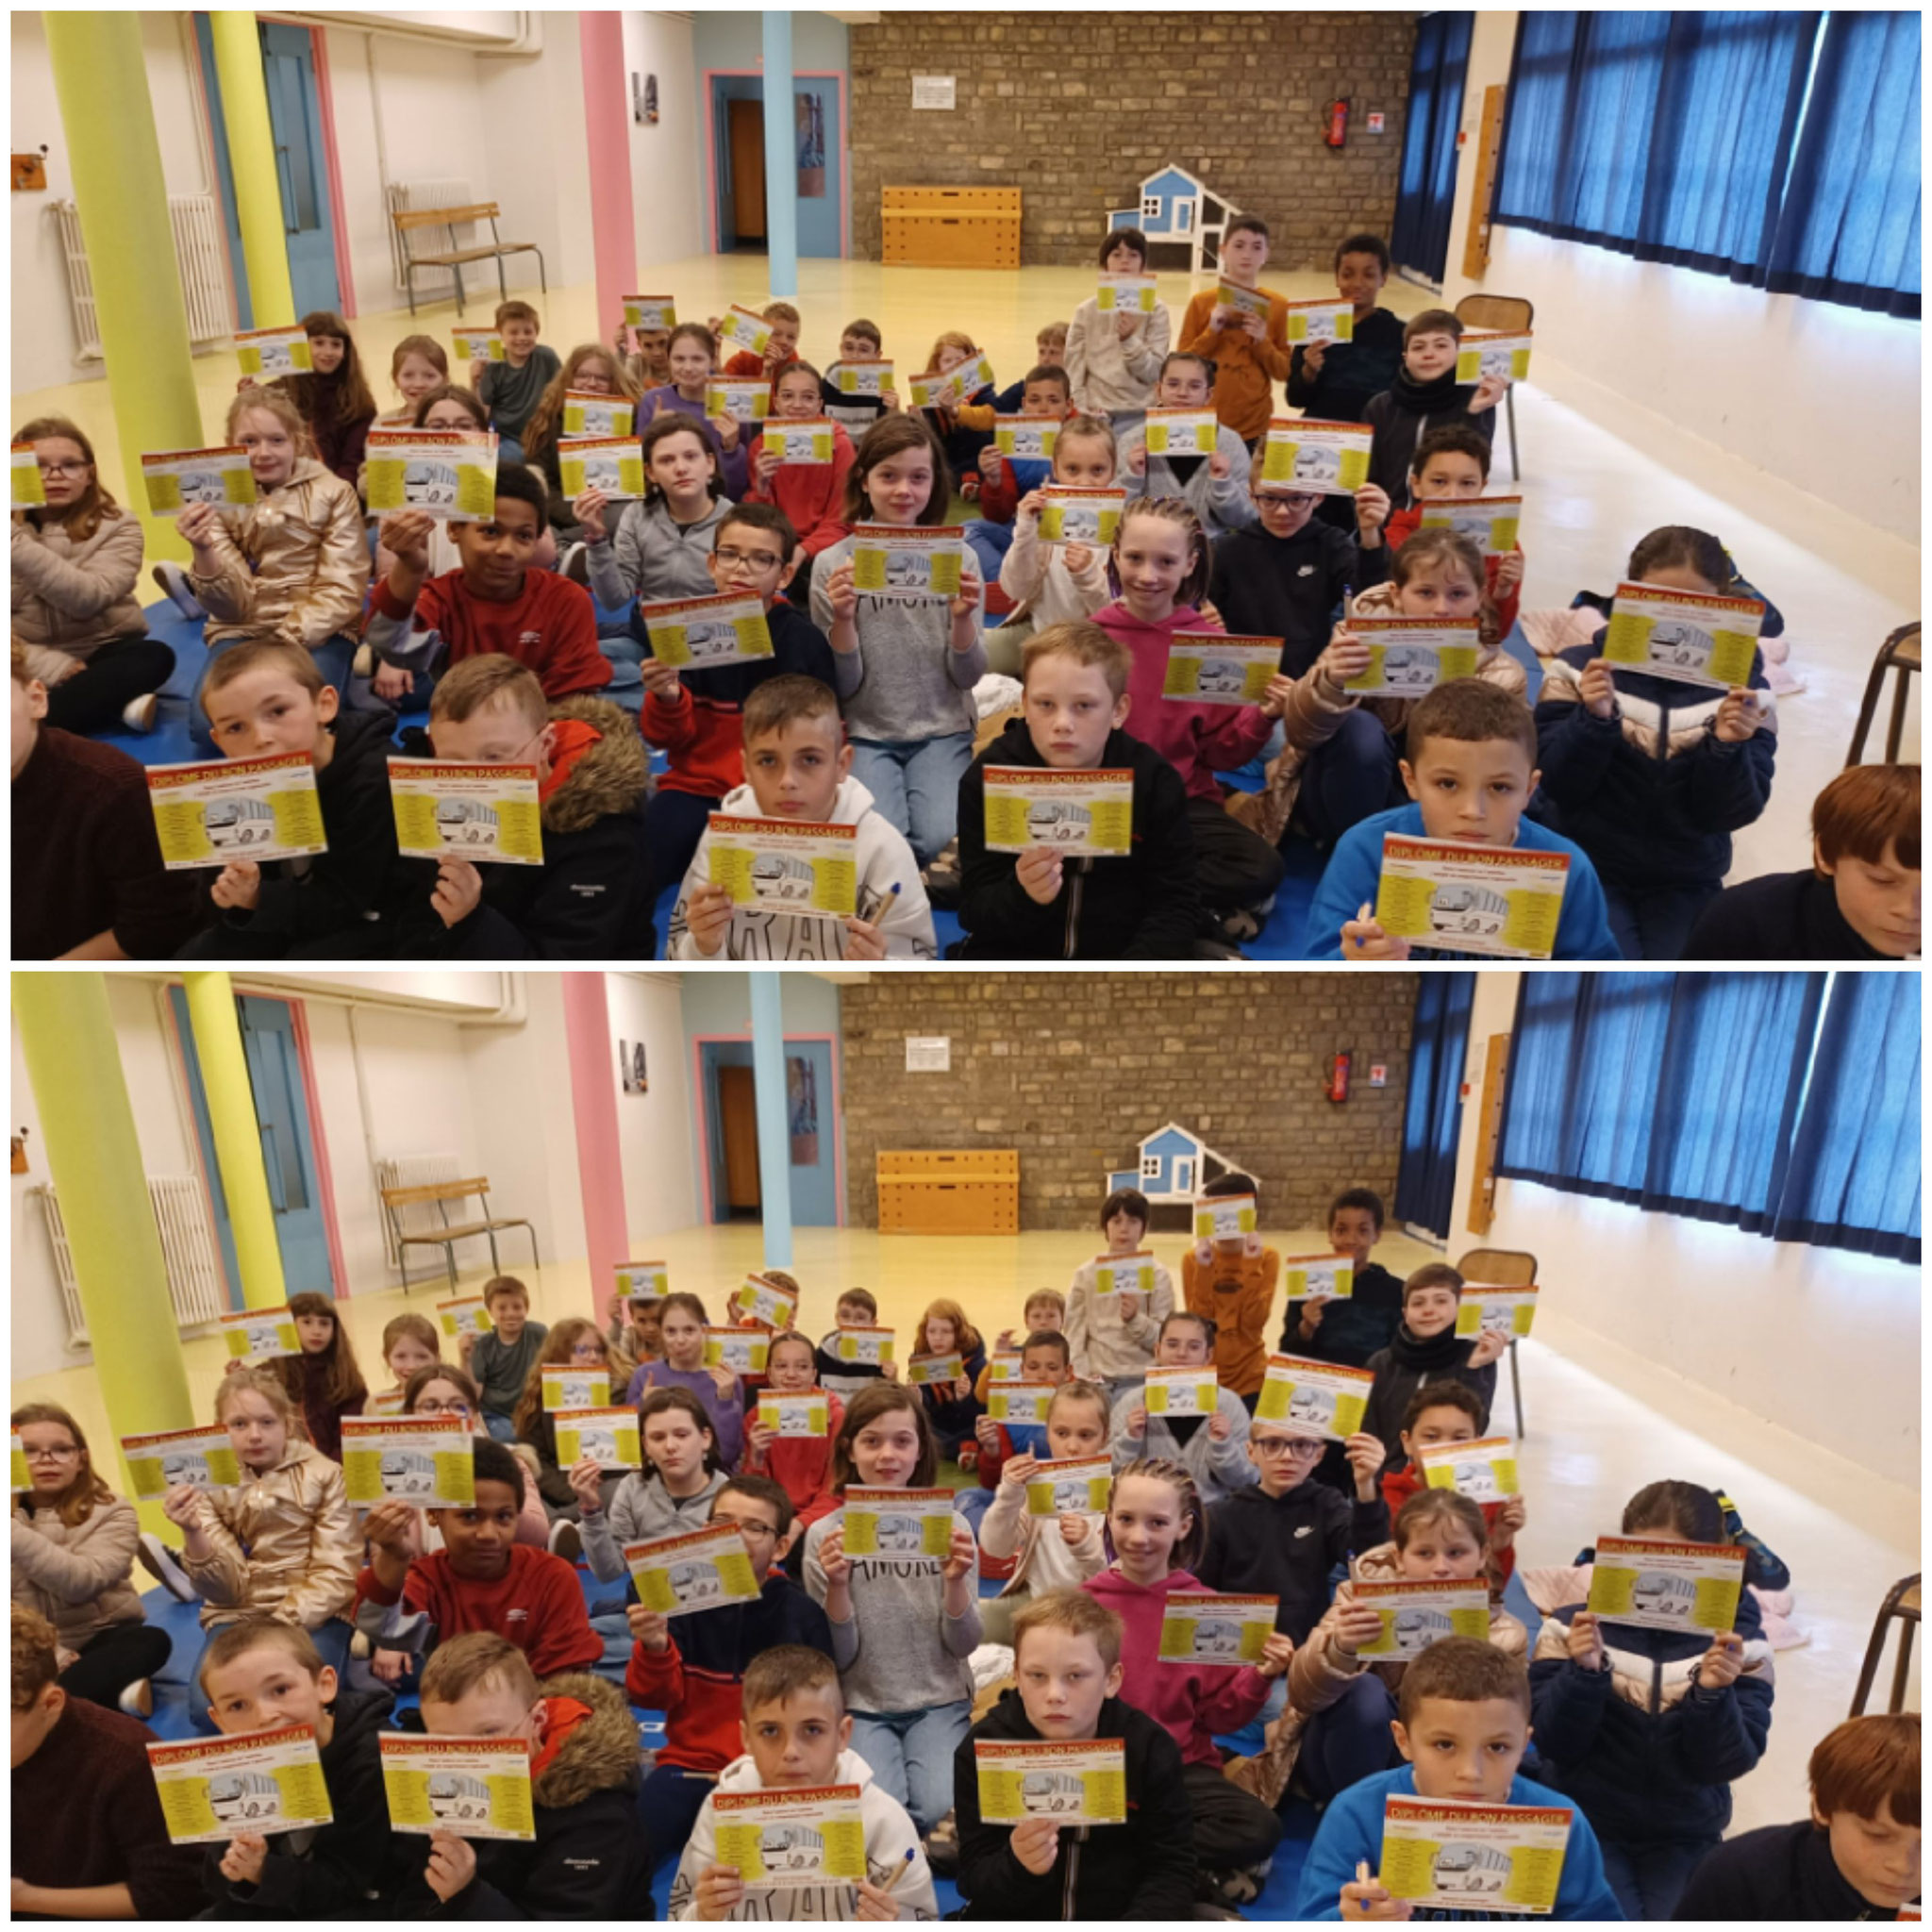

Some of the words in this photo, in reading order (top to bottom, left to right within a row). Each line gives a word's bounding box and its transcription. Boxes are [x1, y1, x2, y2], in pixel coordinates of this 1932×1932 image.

[1446, 851, 1464, 862] DU
[1496, 855, 1563, 869] PASSAGER
[1449, 1811, 1468, 1823] DU
[1501, 1812, 1565, 1825] PASSAGER
